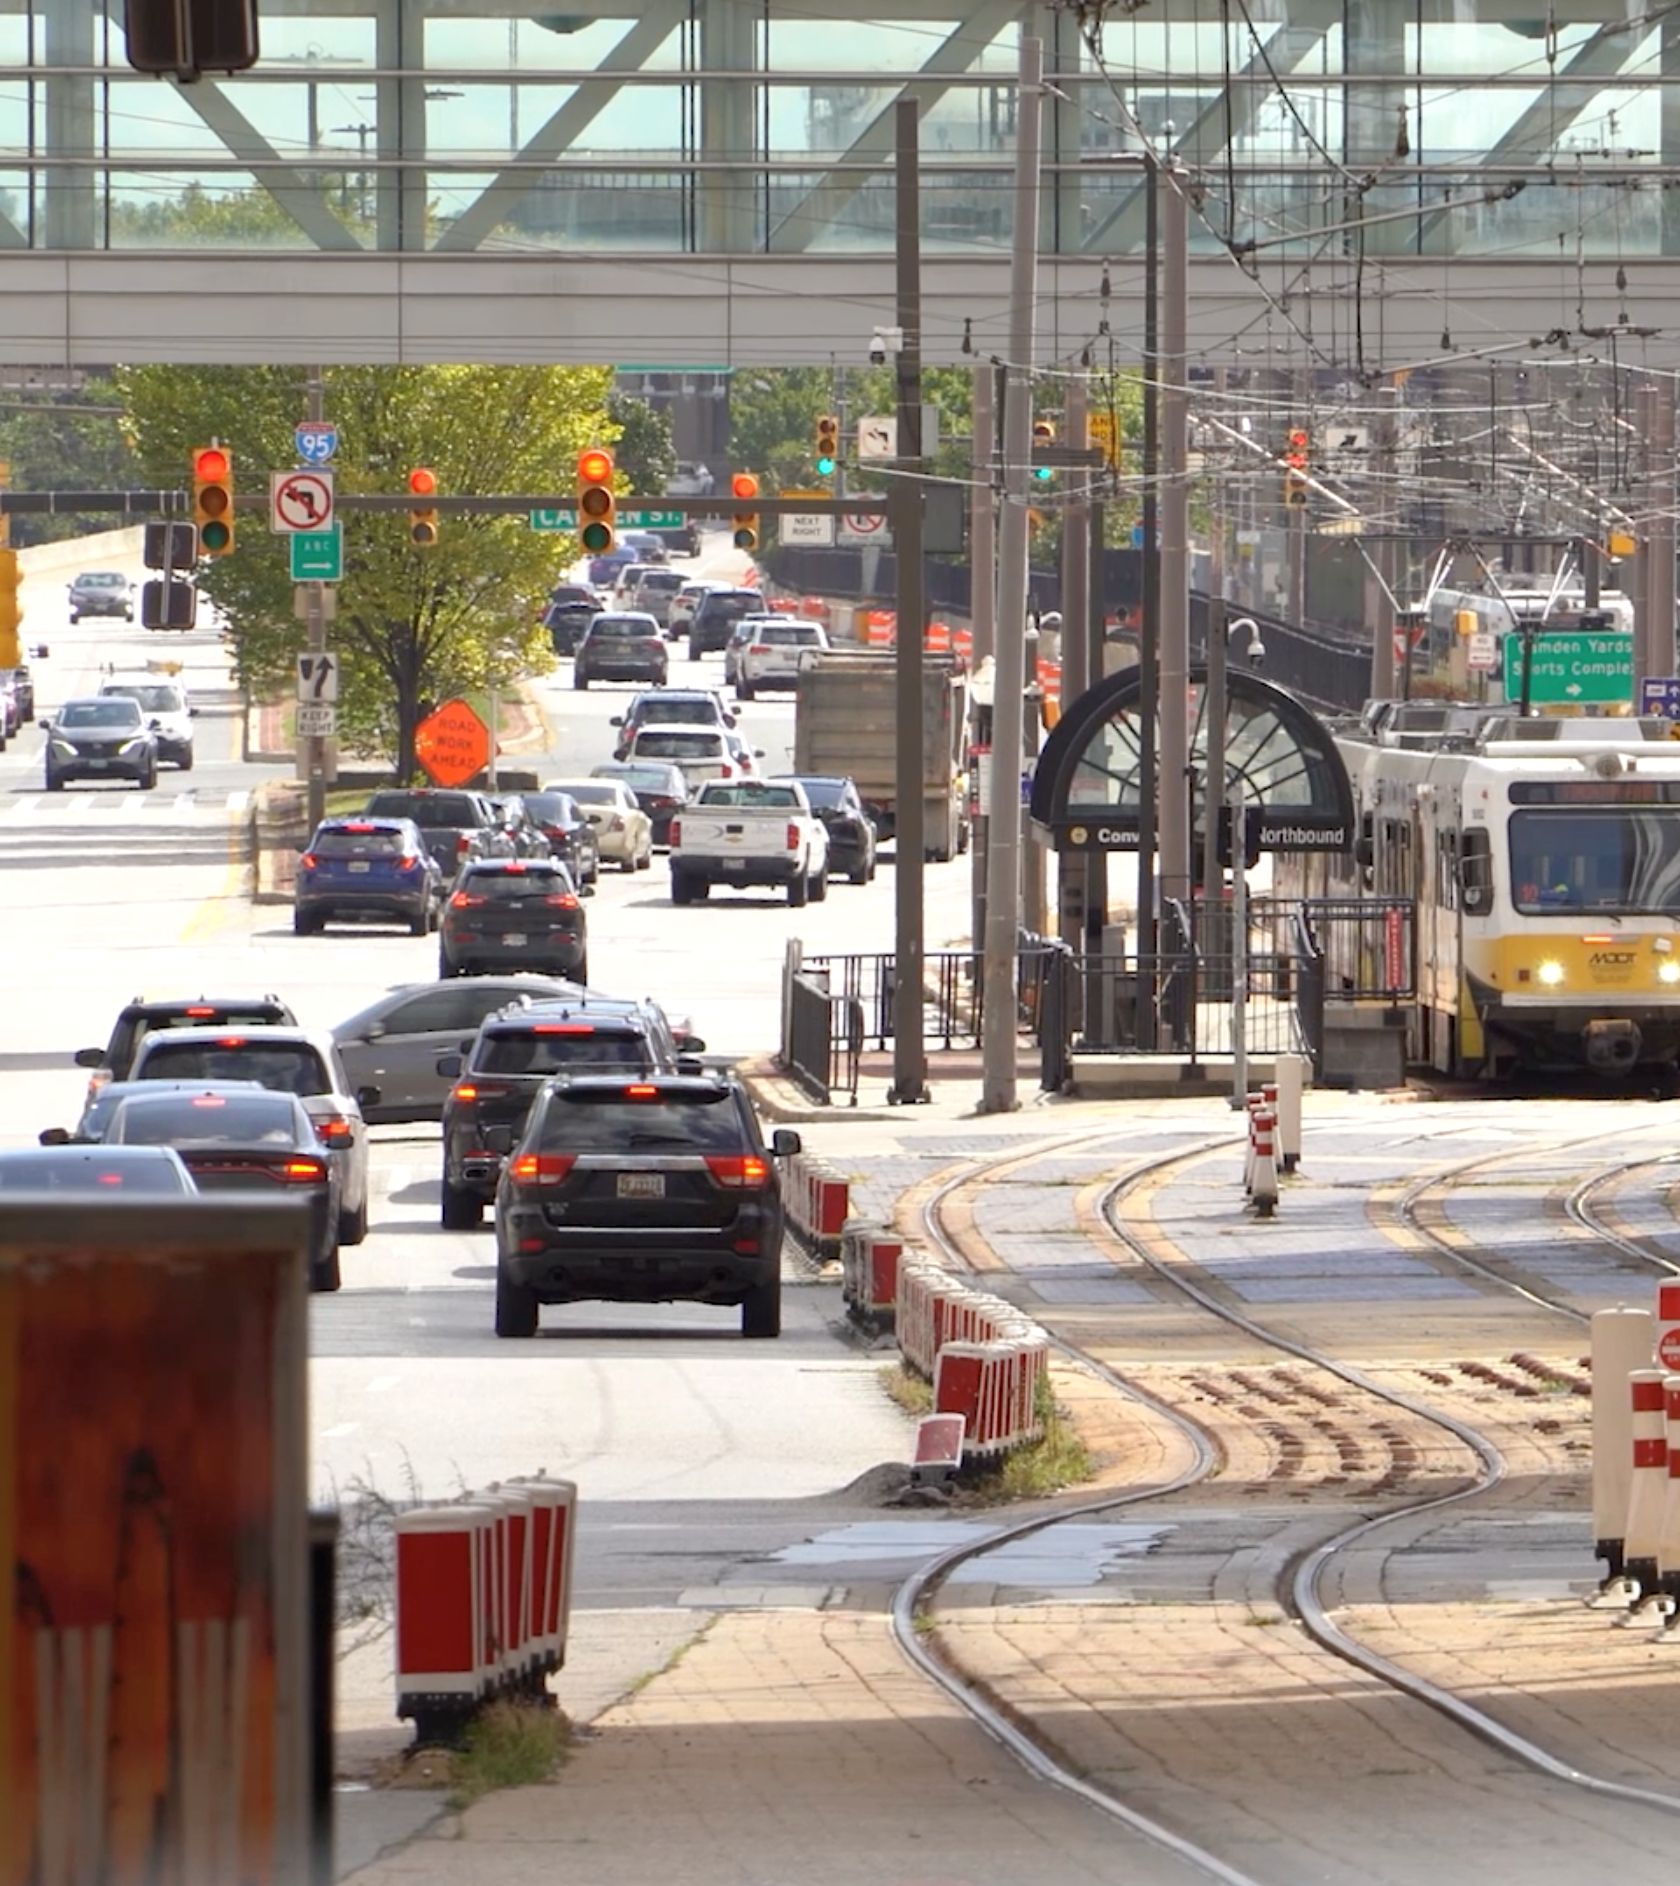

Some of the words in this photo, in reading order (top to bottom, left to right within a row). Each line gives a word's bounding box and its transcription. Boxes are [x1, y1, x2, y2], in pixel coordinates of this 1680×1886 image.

[302, 435, 329, 457] 95
[540, 509, 641, 524] CAEN
[793, 527, 822, 536] RIGHT
[1588, 639, 1632, 653] Yards
[1512, 662, 1565, 676] Sorts
[1571, 661, 1634, 677] Comple
[302, 711, 331, 720] KEEP
[301, 722, 332, 733] RIGHT
[439, 718, 476, 732] ROAD
[437, 736, 472, 748] WORK
[431, 755, 476, 768] AHEAD
